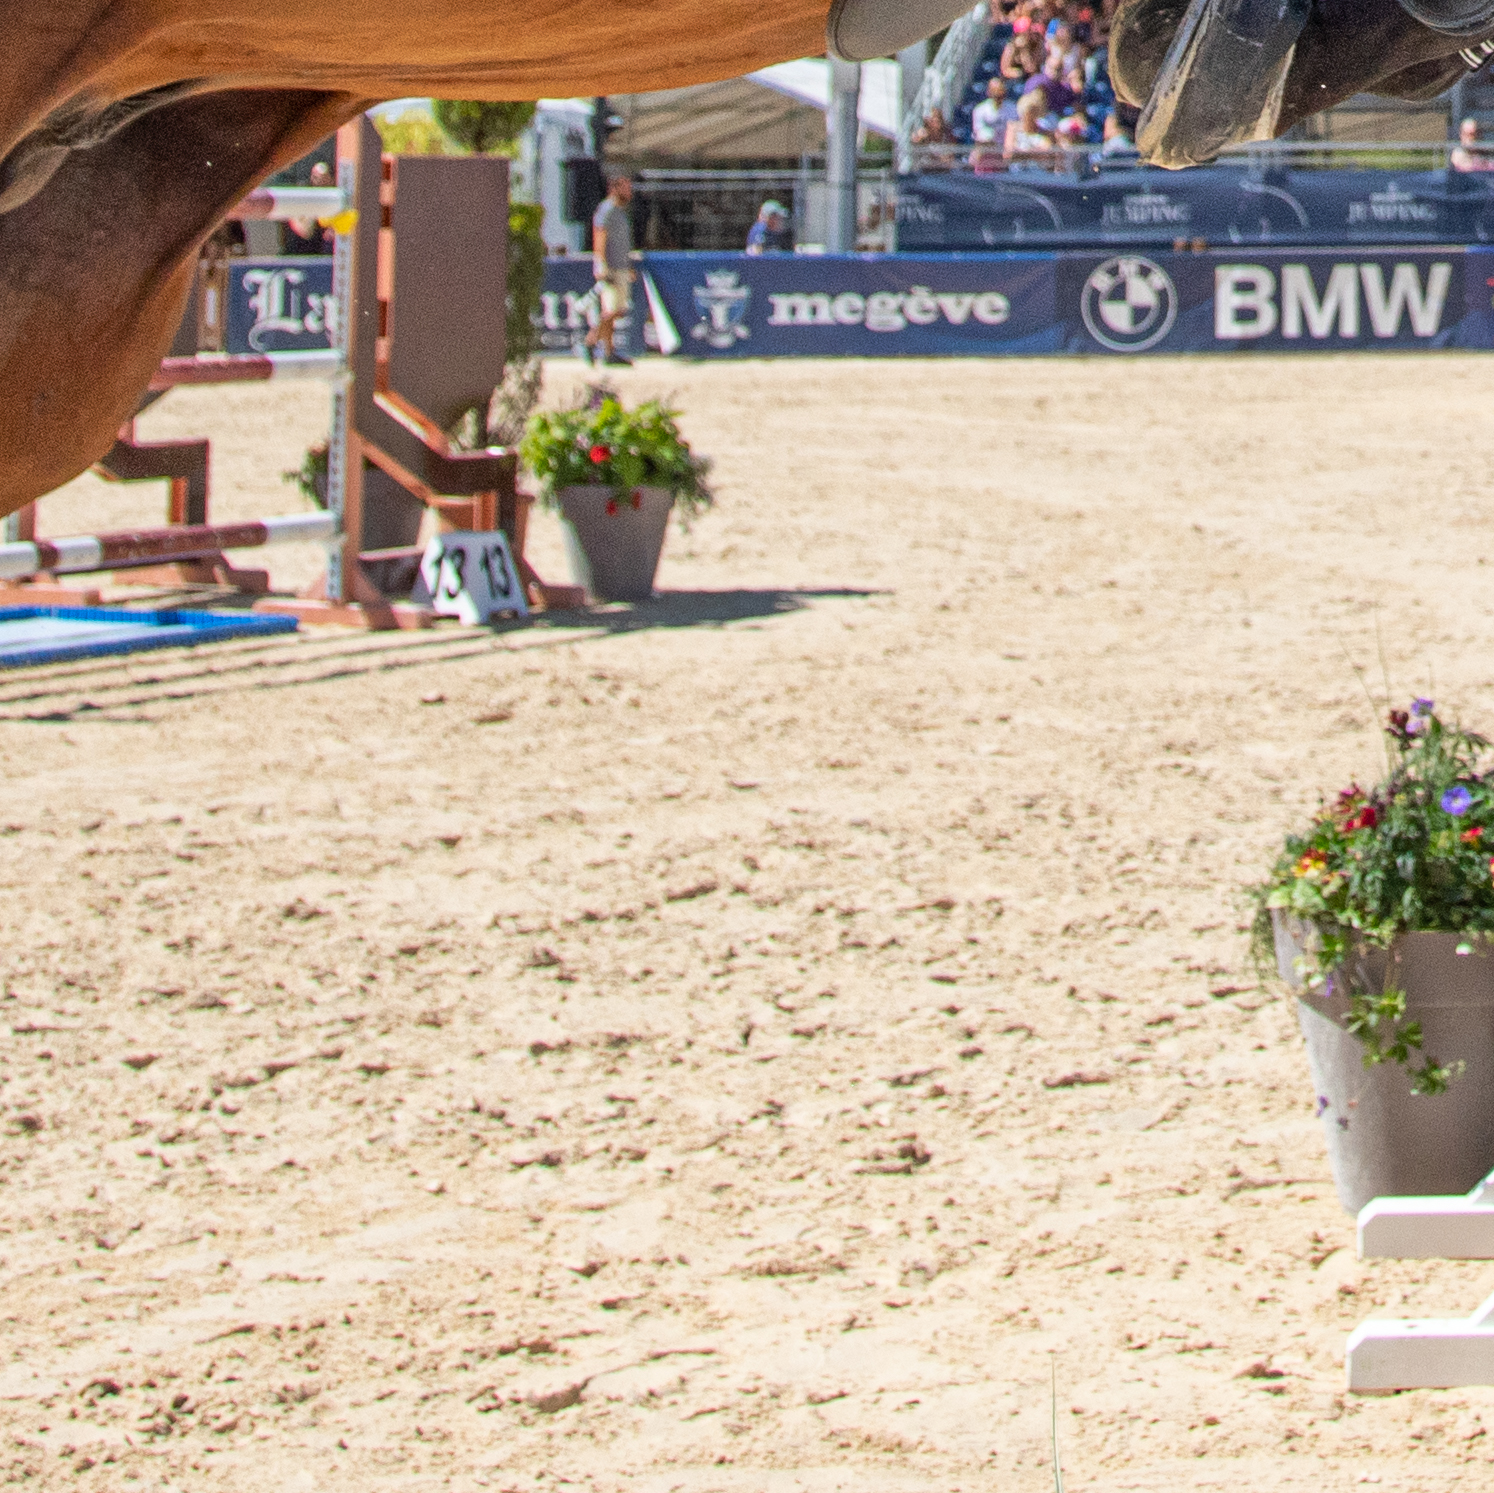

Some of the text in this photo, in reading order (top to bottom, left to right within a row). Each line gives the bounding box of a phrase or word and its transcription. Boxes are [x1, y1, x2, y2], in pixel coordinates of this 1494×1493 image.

[767, 284, 1011, 333] megève
[1213, 262, 1453, 340] BMW
[480, 544, 511, 600] 13
